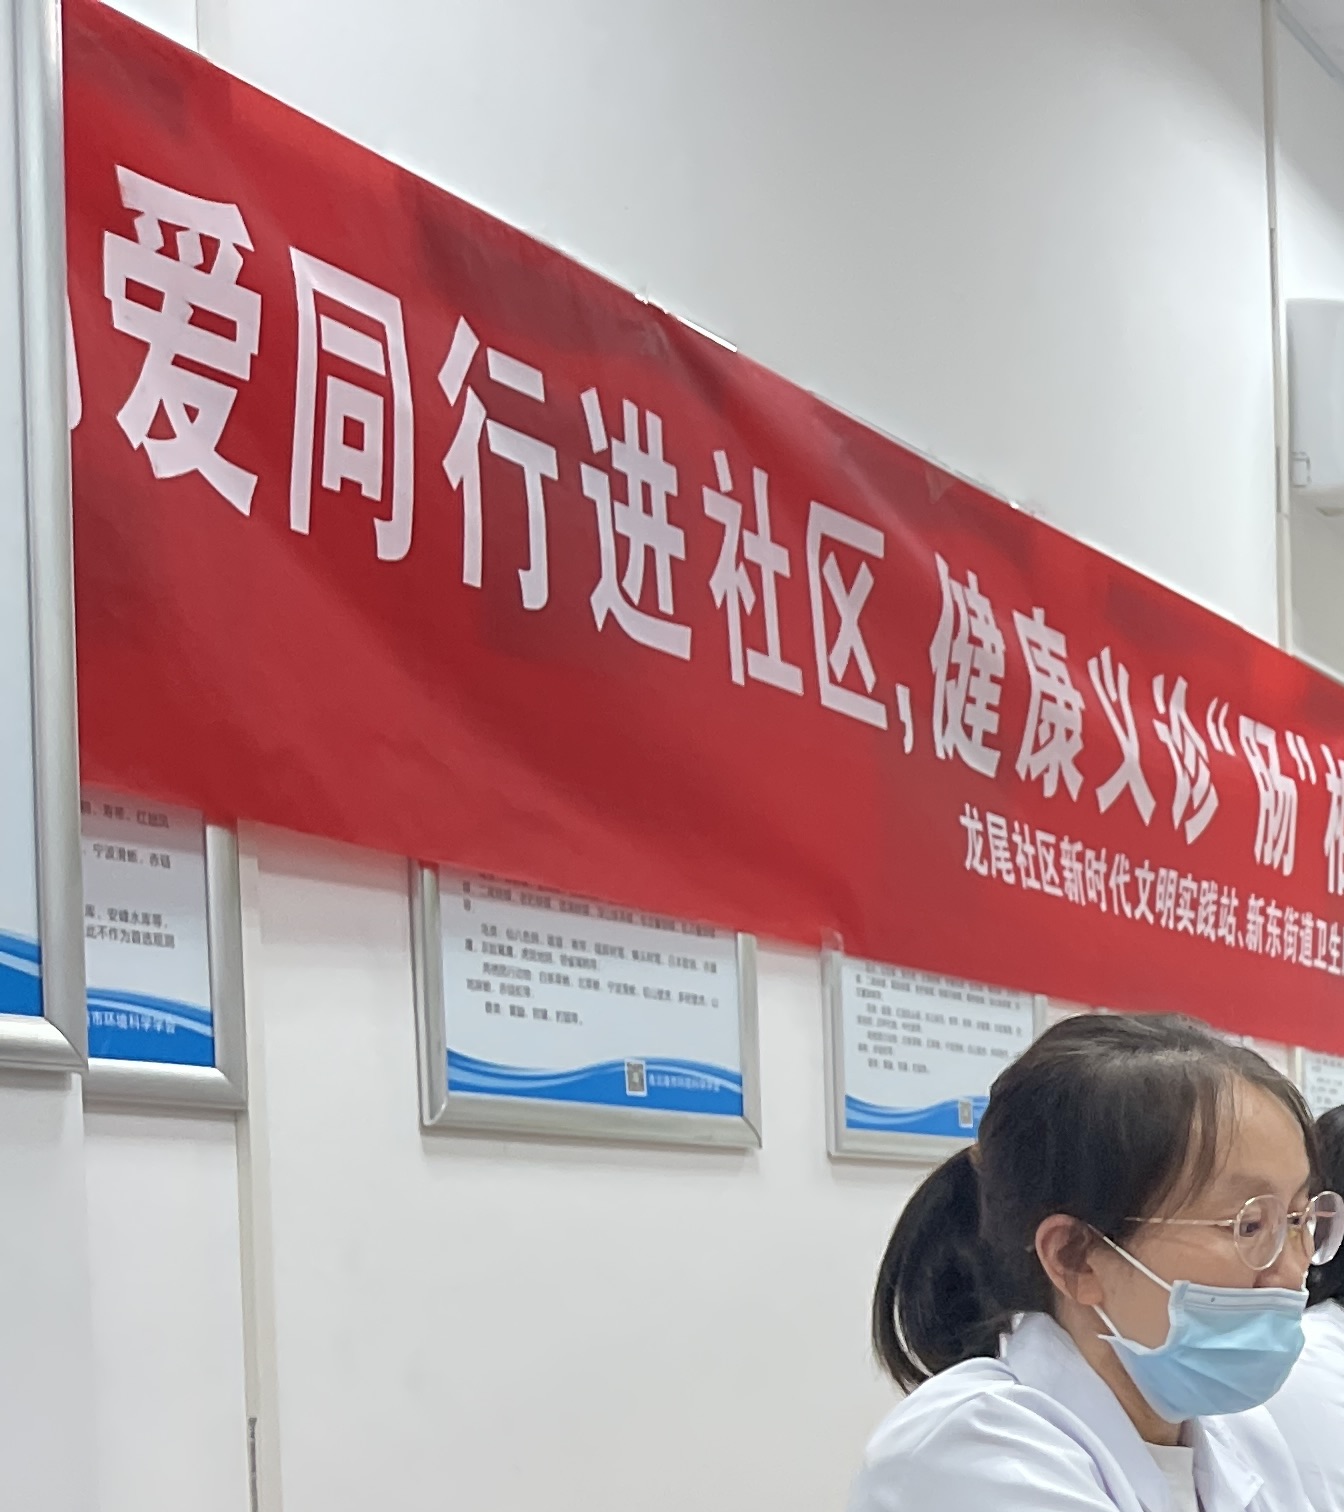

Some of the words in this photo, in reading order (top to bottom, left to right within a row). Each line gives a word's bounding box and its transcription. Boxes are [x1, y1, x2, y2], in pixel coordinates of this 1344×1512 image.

[87, 1011, 176, 1034] 市环境科学学会
